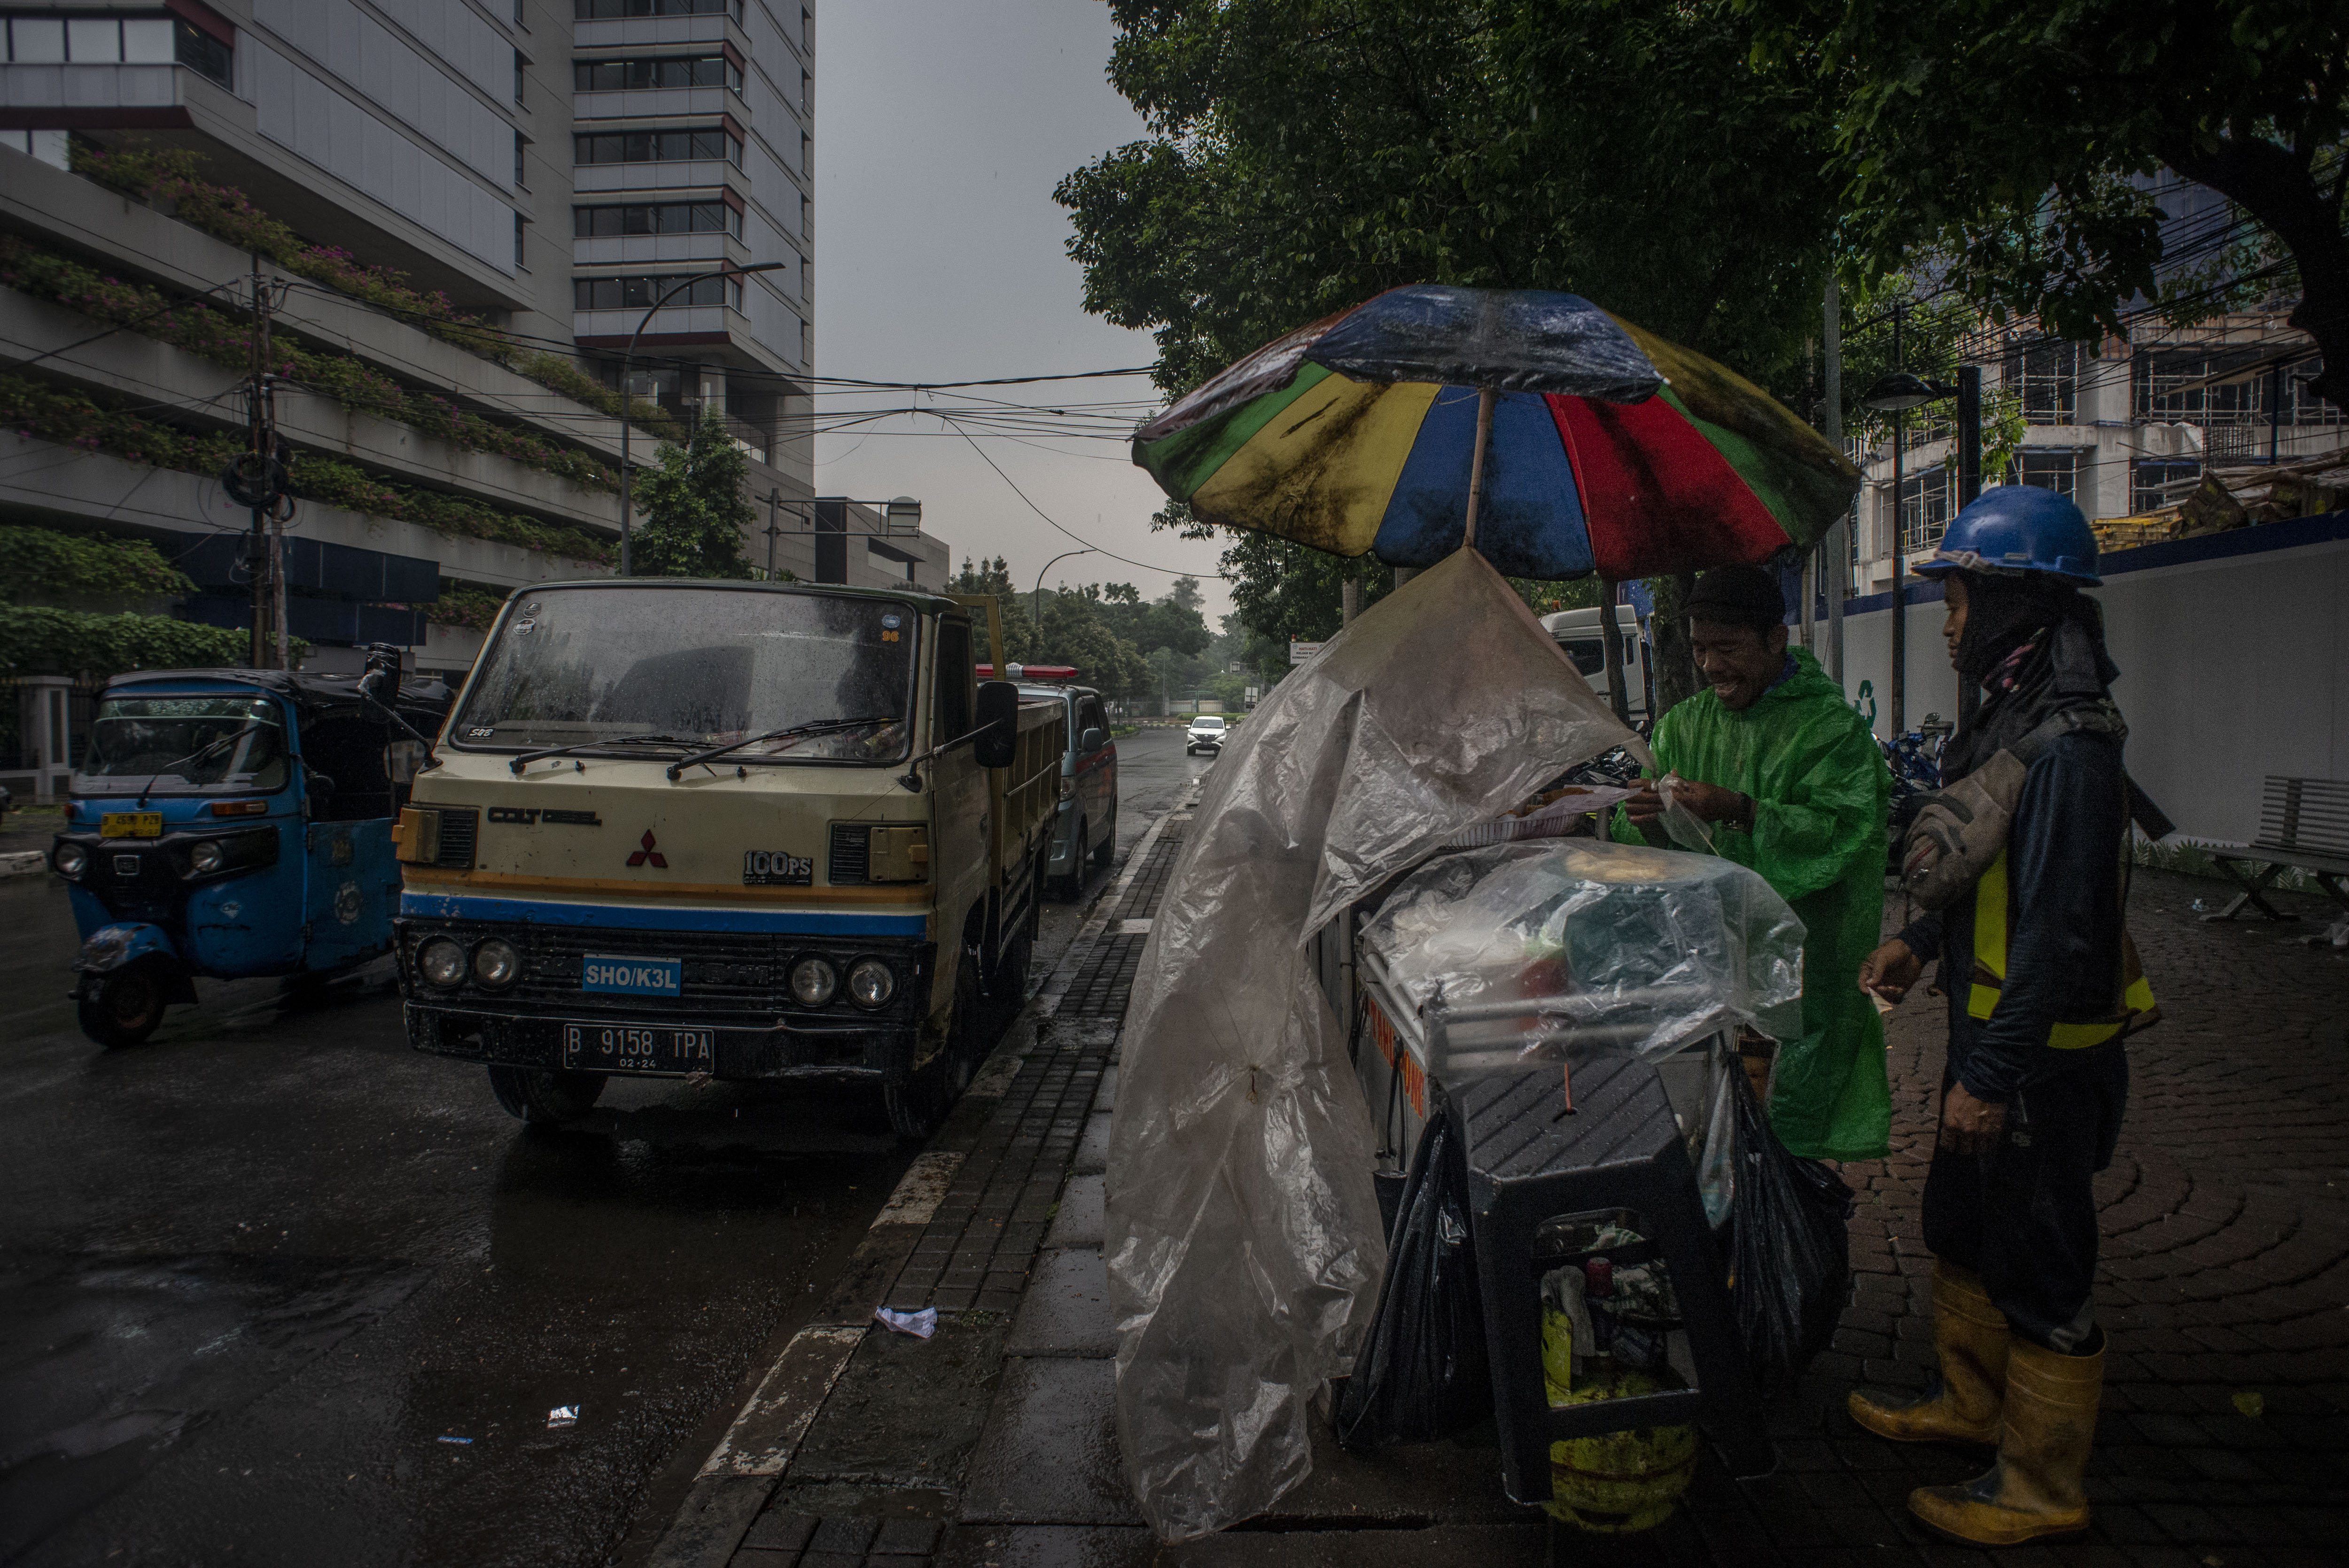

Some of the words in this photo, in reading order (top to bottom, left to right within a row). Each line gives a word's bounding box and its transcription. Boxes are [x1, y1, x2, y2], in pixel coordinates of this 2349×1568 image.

[882, 630, 899, 642] 96
[488, 807, 541, 825] COLT
[585, 964, 677, 989] SHO/K3L
[568, 1027, 582, 1054] B
[601, 1029, 653, 1056] 9158
[674, 1032, 710, 1059] TPA
